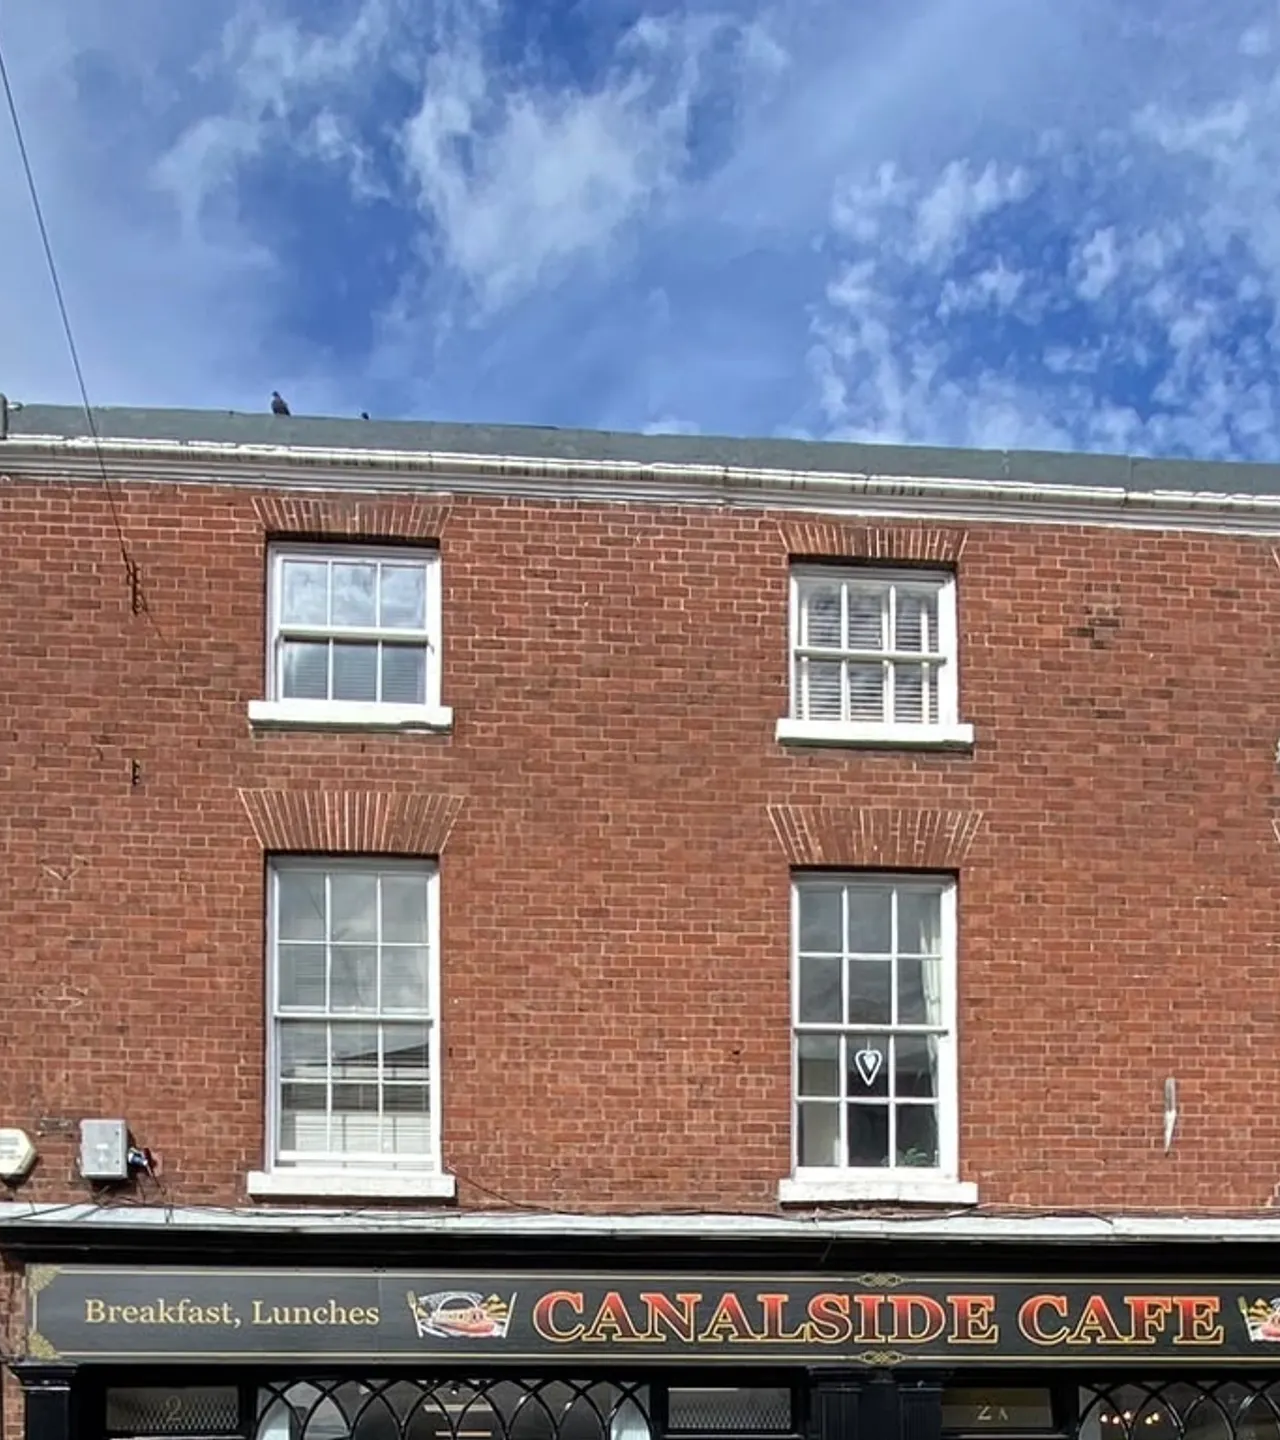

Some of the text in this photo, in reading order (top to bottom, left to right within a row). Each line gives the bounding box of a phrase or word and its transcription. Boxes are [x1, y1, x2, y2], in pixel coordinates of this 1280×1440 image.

[84, 1298, 380, 1328] Breakfast, Lunches
[532, 1291, 1224, 1346] CANALSIDE CAFE
